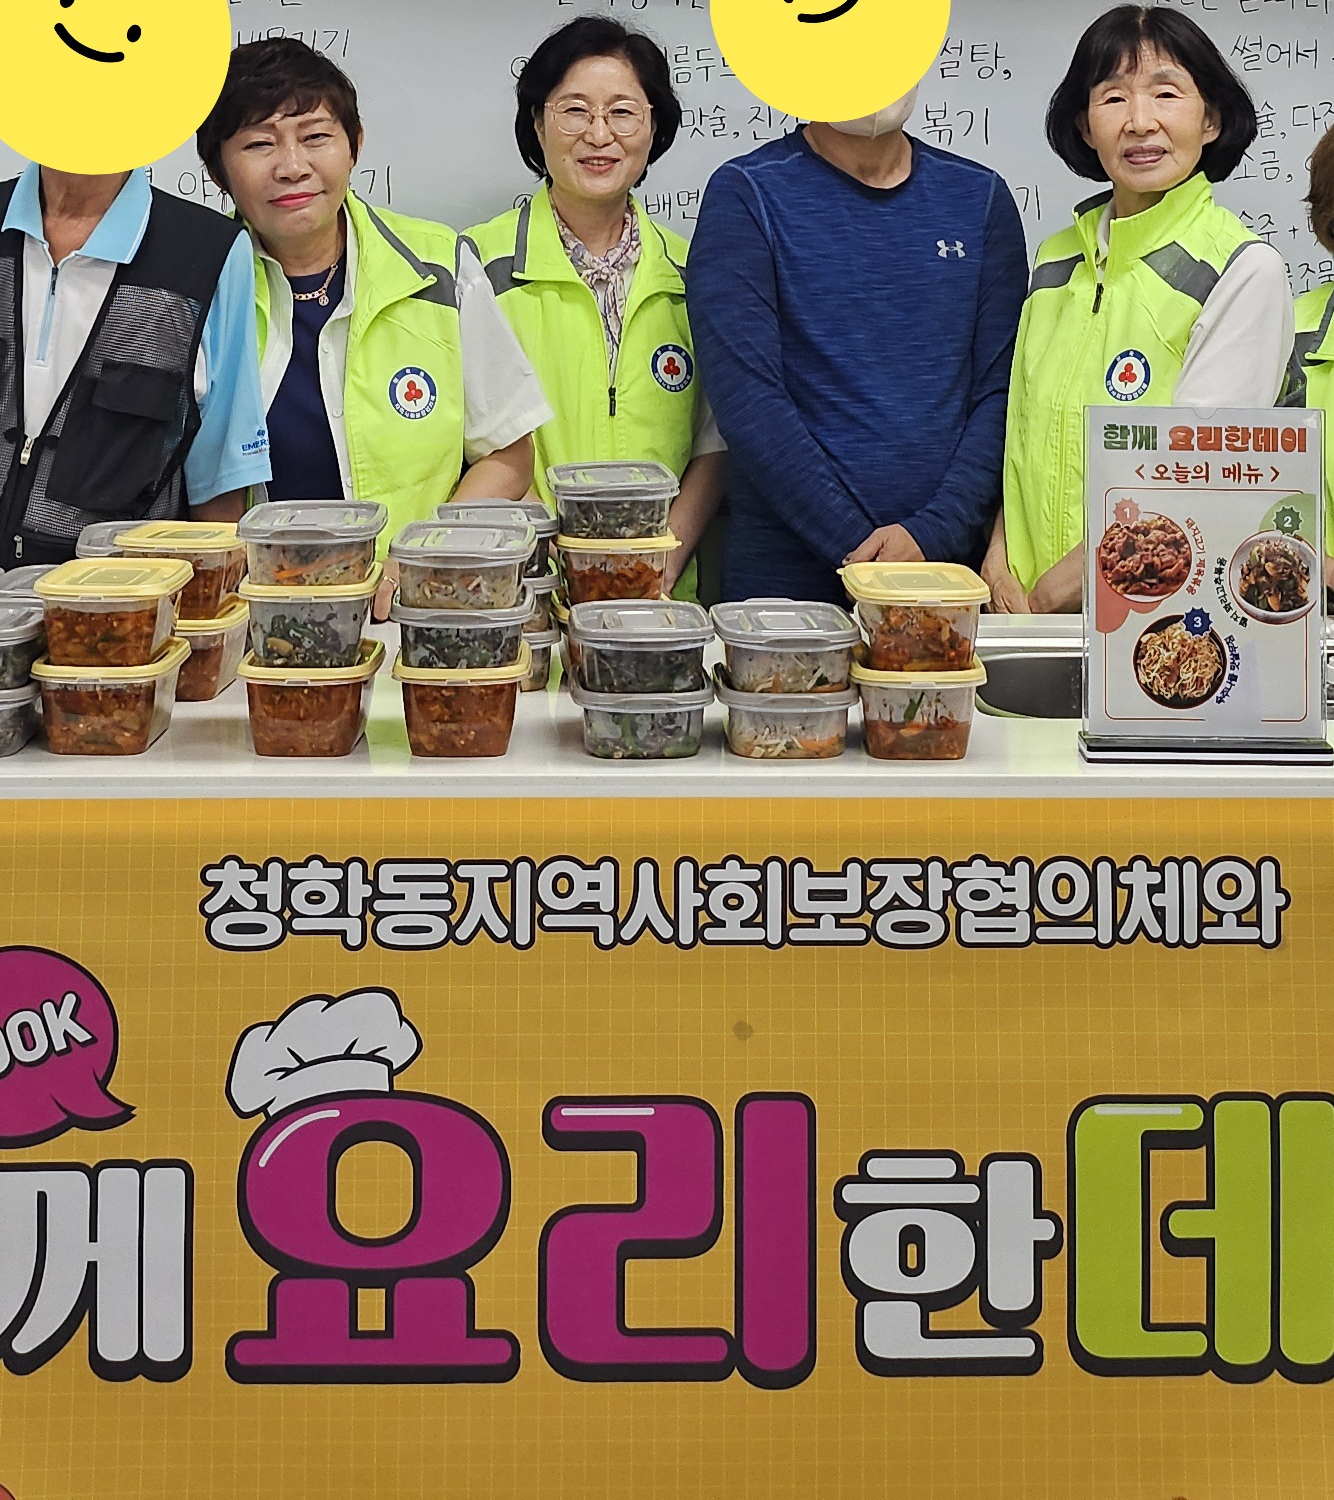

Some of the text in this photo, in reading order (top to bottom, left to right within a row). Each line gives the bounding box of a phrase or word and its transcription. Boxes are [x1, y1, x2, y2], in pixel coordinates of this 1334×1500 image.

[938, 39, 1012, 82] 설탕,
[1229, 34, 1319, 74] 썰어서
[920, 102, 992, 146] 볶기
[242, 439, 269, 451] EMER
[1104, 423, 1307, 453] 함께 요리한데이
[1151, 461, 1210, 484] 오늘의
[1222, 462, 1264, 485] 메뉴
[1124, 508, 1131, 518] 1
[1283, 516, 1292, 527] 2
[1185, 517, 1207, 555] 돼지고기
[1193, 616, 1203, 628] 3
[202, 855, 1290, 952] 청학동지역사회보장협의체와
